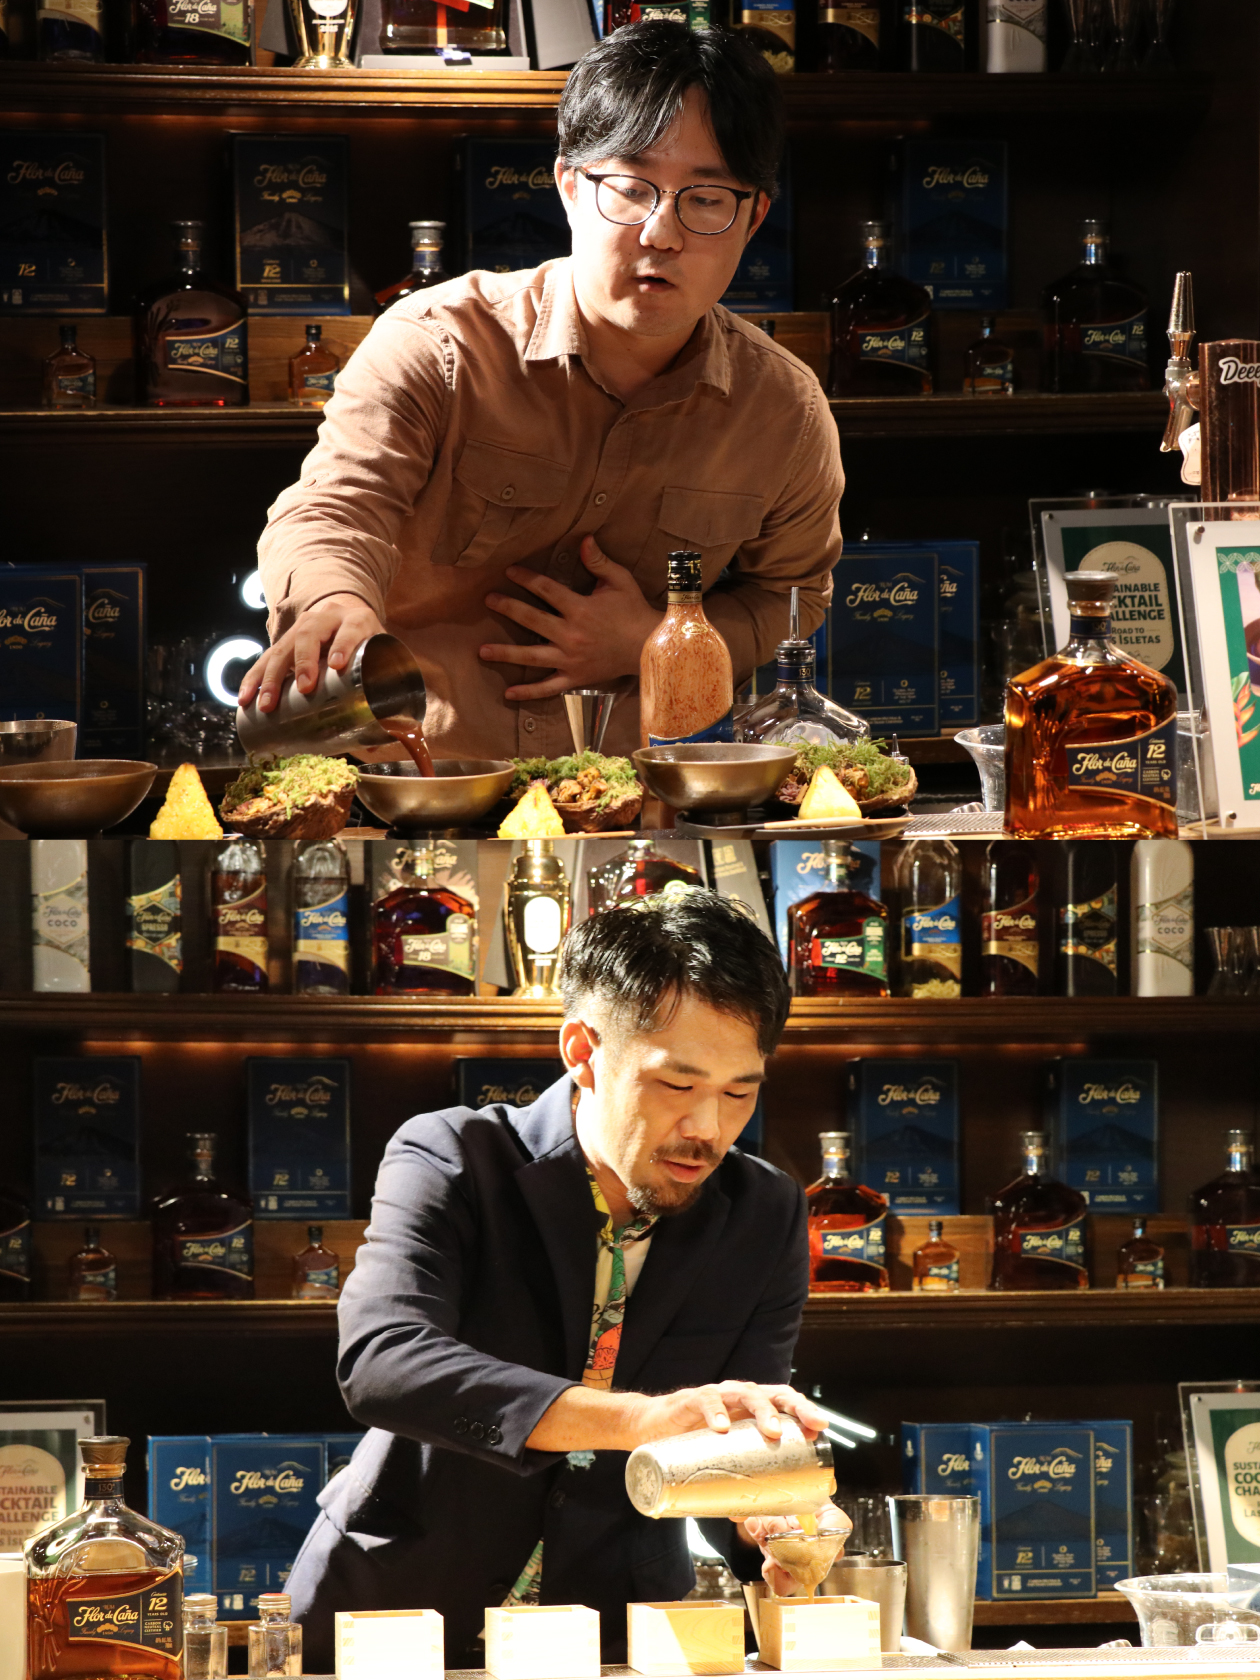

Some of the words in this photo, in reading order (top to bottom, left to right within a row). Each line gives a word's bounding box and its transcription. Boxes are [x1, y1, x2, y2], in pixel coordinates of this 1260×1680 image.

[184, 13, 199, 24] 18
[8, 160, 43, 184] Flor
[55, 161, 85, 185] Caña
[254, 164, 288, 187] Flor
[299, 164, 328, 188] Caña
[923, 166, 954, 189] Flor
[963, 166, 989, 188] Caña
[18, 263, 36, 276] 12
[263, 265, 281, 279] 12
[911, 329, 924, 341] 12
[1132, 325, 1145, 336] 12
[225, 337, 239, 349] 12
[846, 583, 880, 607] Flor
[890, 581, 918, 606] Caña
[1114, 583, 1160, 593] AINABLE
[1113, 595, 1162, 608] KTAIL
[88, 598, 120, 623] Caña
[1110, 609, 1165, 621] ALLENGE
[13, 614, 24, 624] de
[24, 607, 57, 632] Caña
[1119, 635, 1161, 645] ISLETAS
[854, 687, 871, 700] 12
[1146, 744, 1166, 758] 12
[1072, 752, 1103, 775] Flor
[1103, 757, 1112, 767] de
[1111, 751, 1137, 773] Caña
[418, 951, 431, 961] 18
[515, 1084, 540, 1106] Cañ
[869, 1229, 882, 1240] 12
[1068, 1229, 1081, 1240] 12
[938, 1453, 969, 1478] Flor
[1008, 1457, 1040, 1479] Flor
[1049, 1456, 1076, 1479] Caña
[170, 1467, 206, 1490] Flor
[230, 1471, 266, 1494] Flor
[275, 1470, 304, 1493] Caña
[0, 1486, 57, 1495] TAINABLE
[2, 1497, 57, 1510] CKTAIL
[0, 1512, 59, 1523] ALLENGE
[1016, 1552, 1033, 1563] 12
[148, 1597, 168, 1611] 12
[74, 1606, 104, 1626] Flor
[105, 1610, 114, 1619] de
[113, 1604, 138, 1624] Caña
